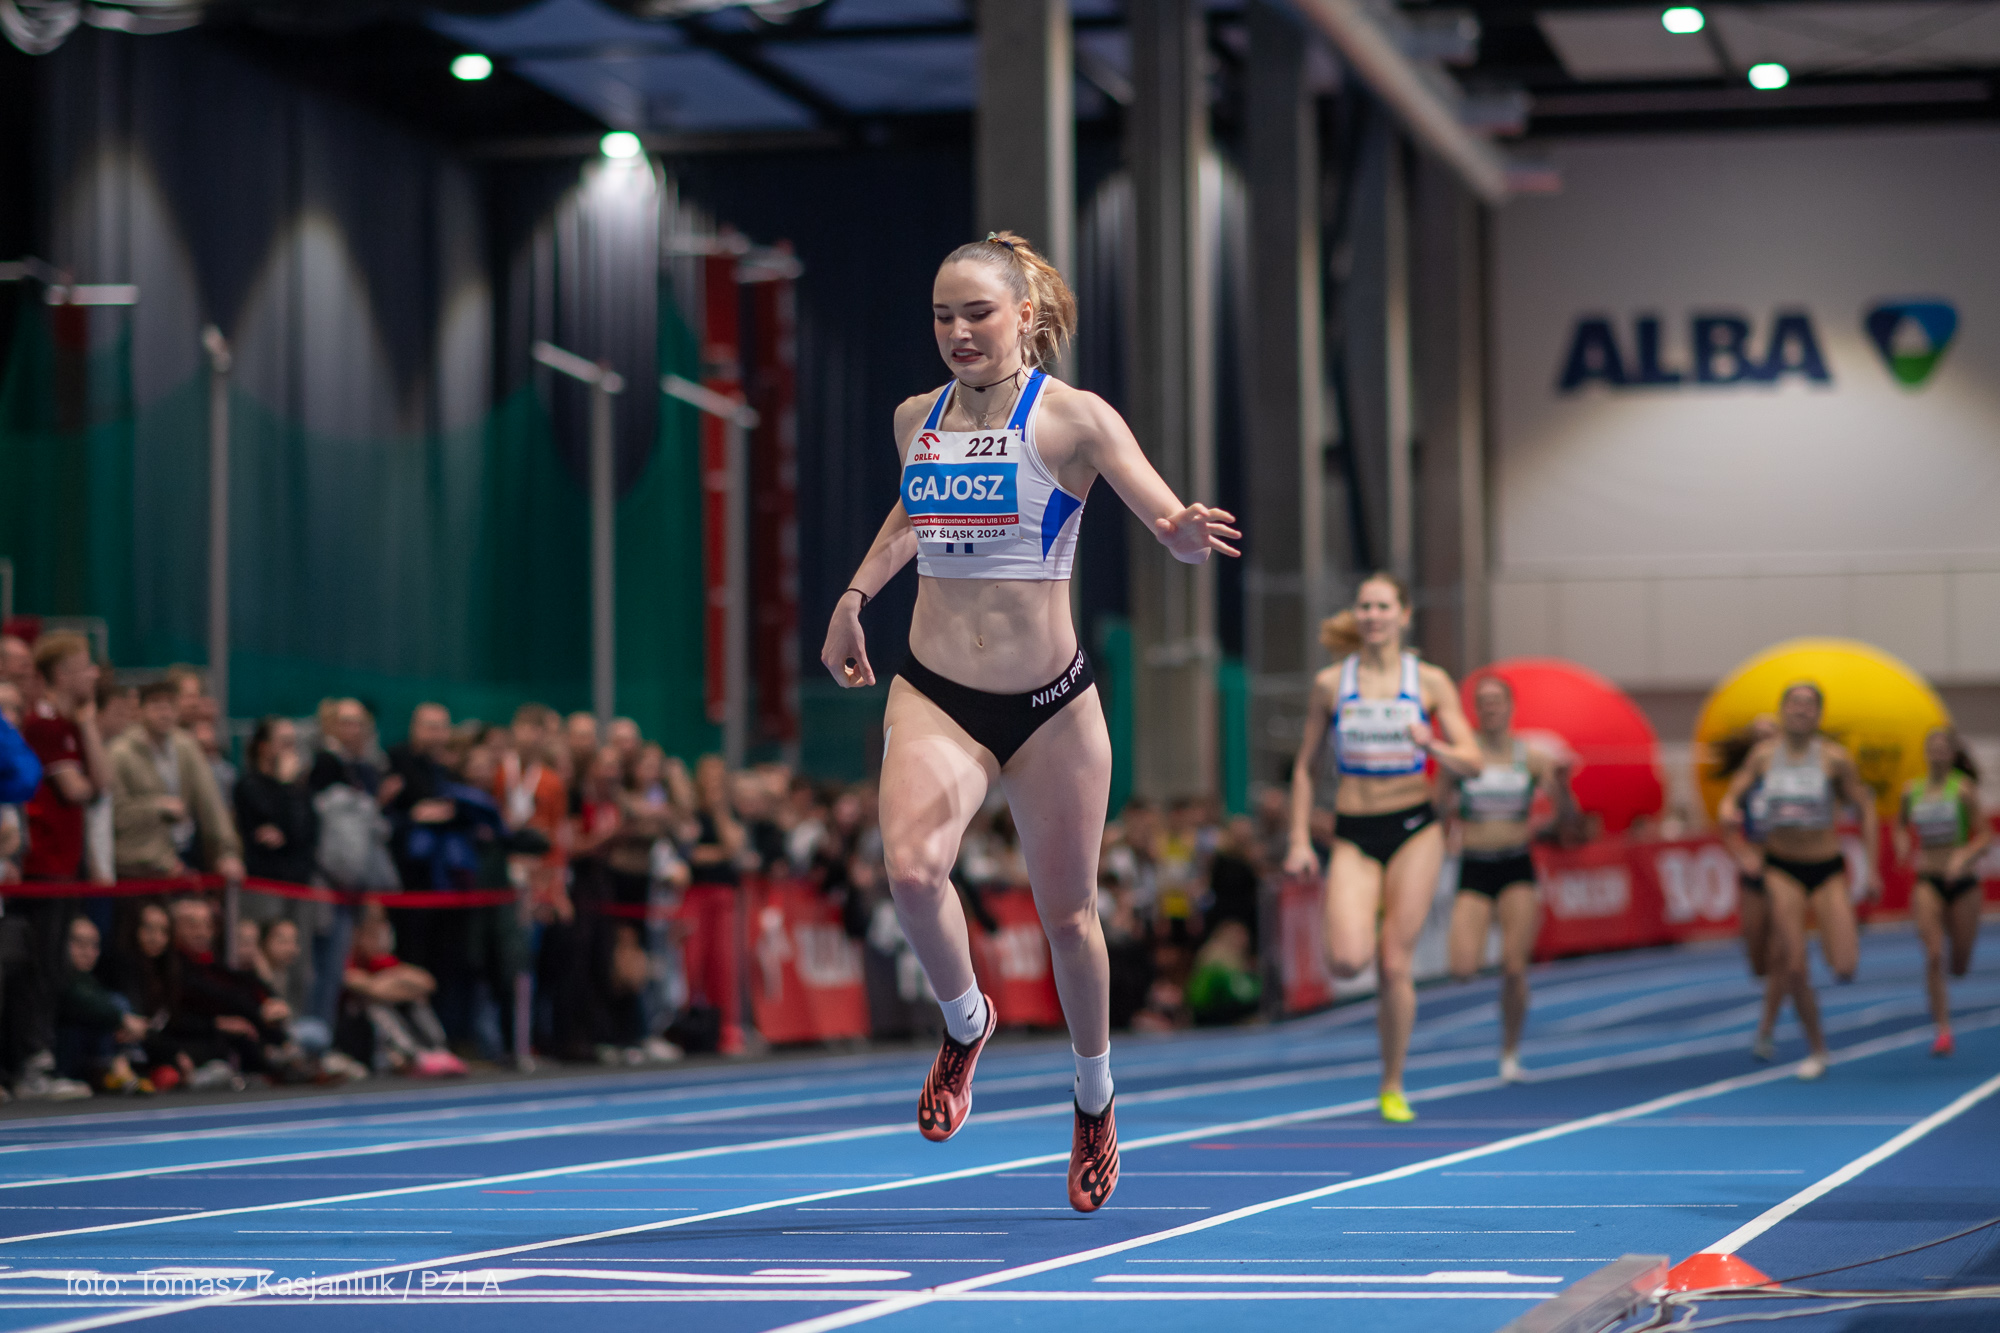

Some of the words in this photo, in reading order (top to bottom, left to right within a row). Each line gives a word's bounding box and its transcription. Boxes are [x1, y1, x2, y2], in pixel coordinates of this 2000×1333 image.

[1558, 315, 1832, 389] ALBA
[914, 453, 940, 462] ORLEN
[965, 436, 1008, 458] 221
[908, 475, 1004, 502] GAJOSZ
[939, 527, 974, 541] ŚLĄSK
[977, 529, 1006, 538] 2024
[1032, 677, 1070, 708] NIKE
